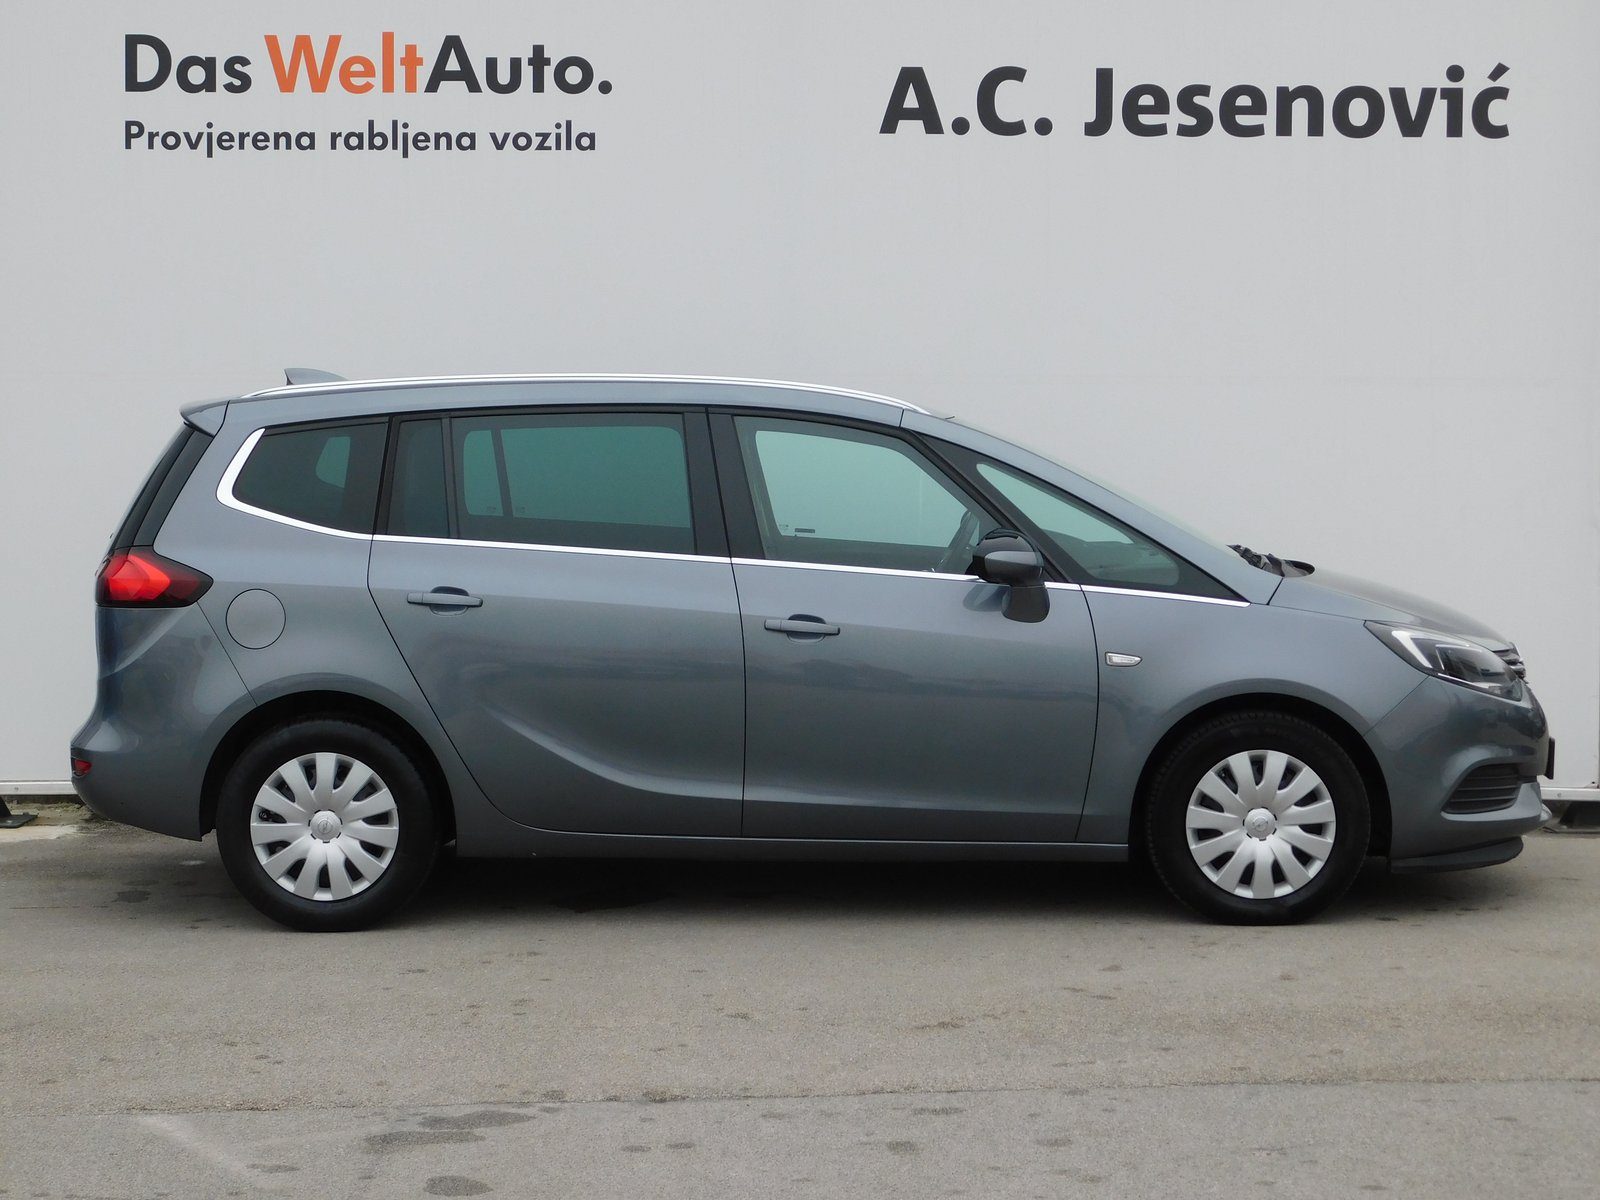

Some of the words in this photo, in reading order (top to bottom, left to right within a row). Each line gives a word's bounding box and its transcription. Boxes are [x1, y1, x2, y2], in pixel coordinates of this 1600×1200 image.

[124, 33, 252, 94] Das
[264, 31, 613, 95] WeltAuto.
[879, 65, 1053, 136] A.C.
[1084, 62, 1511, 139] Jesenović
[124, 120, 316, 159] Provjerena
[330, 119, 477, 159] rabljena
[488, 119, 596, 152] vozila
